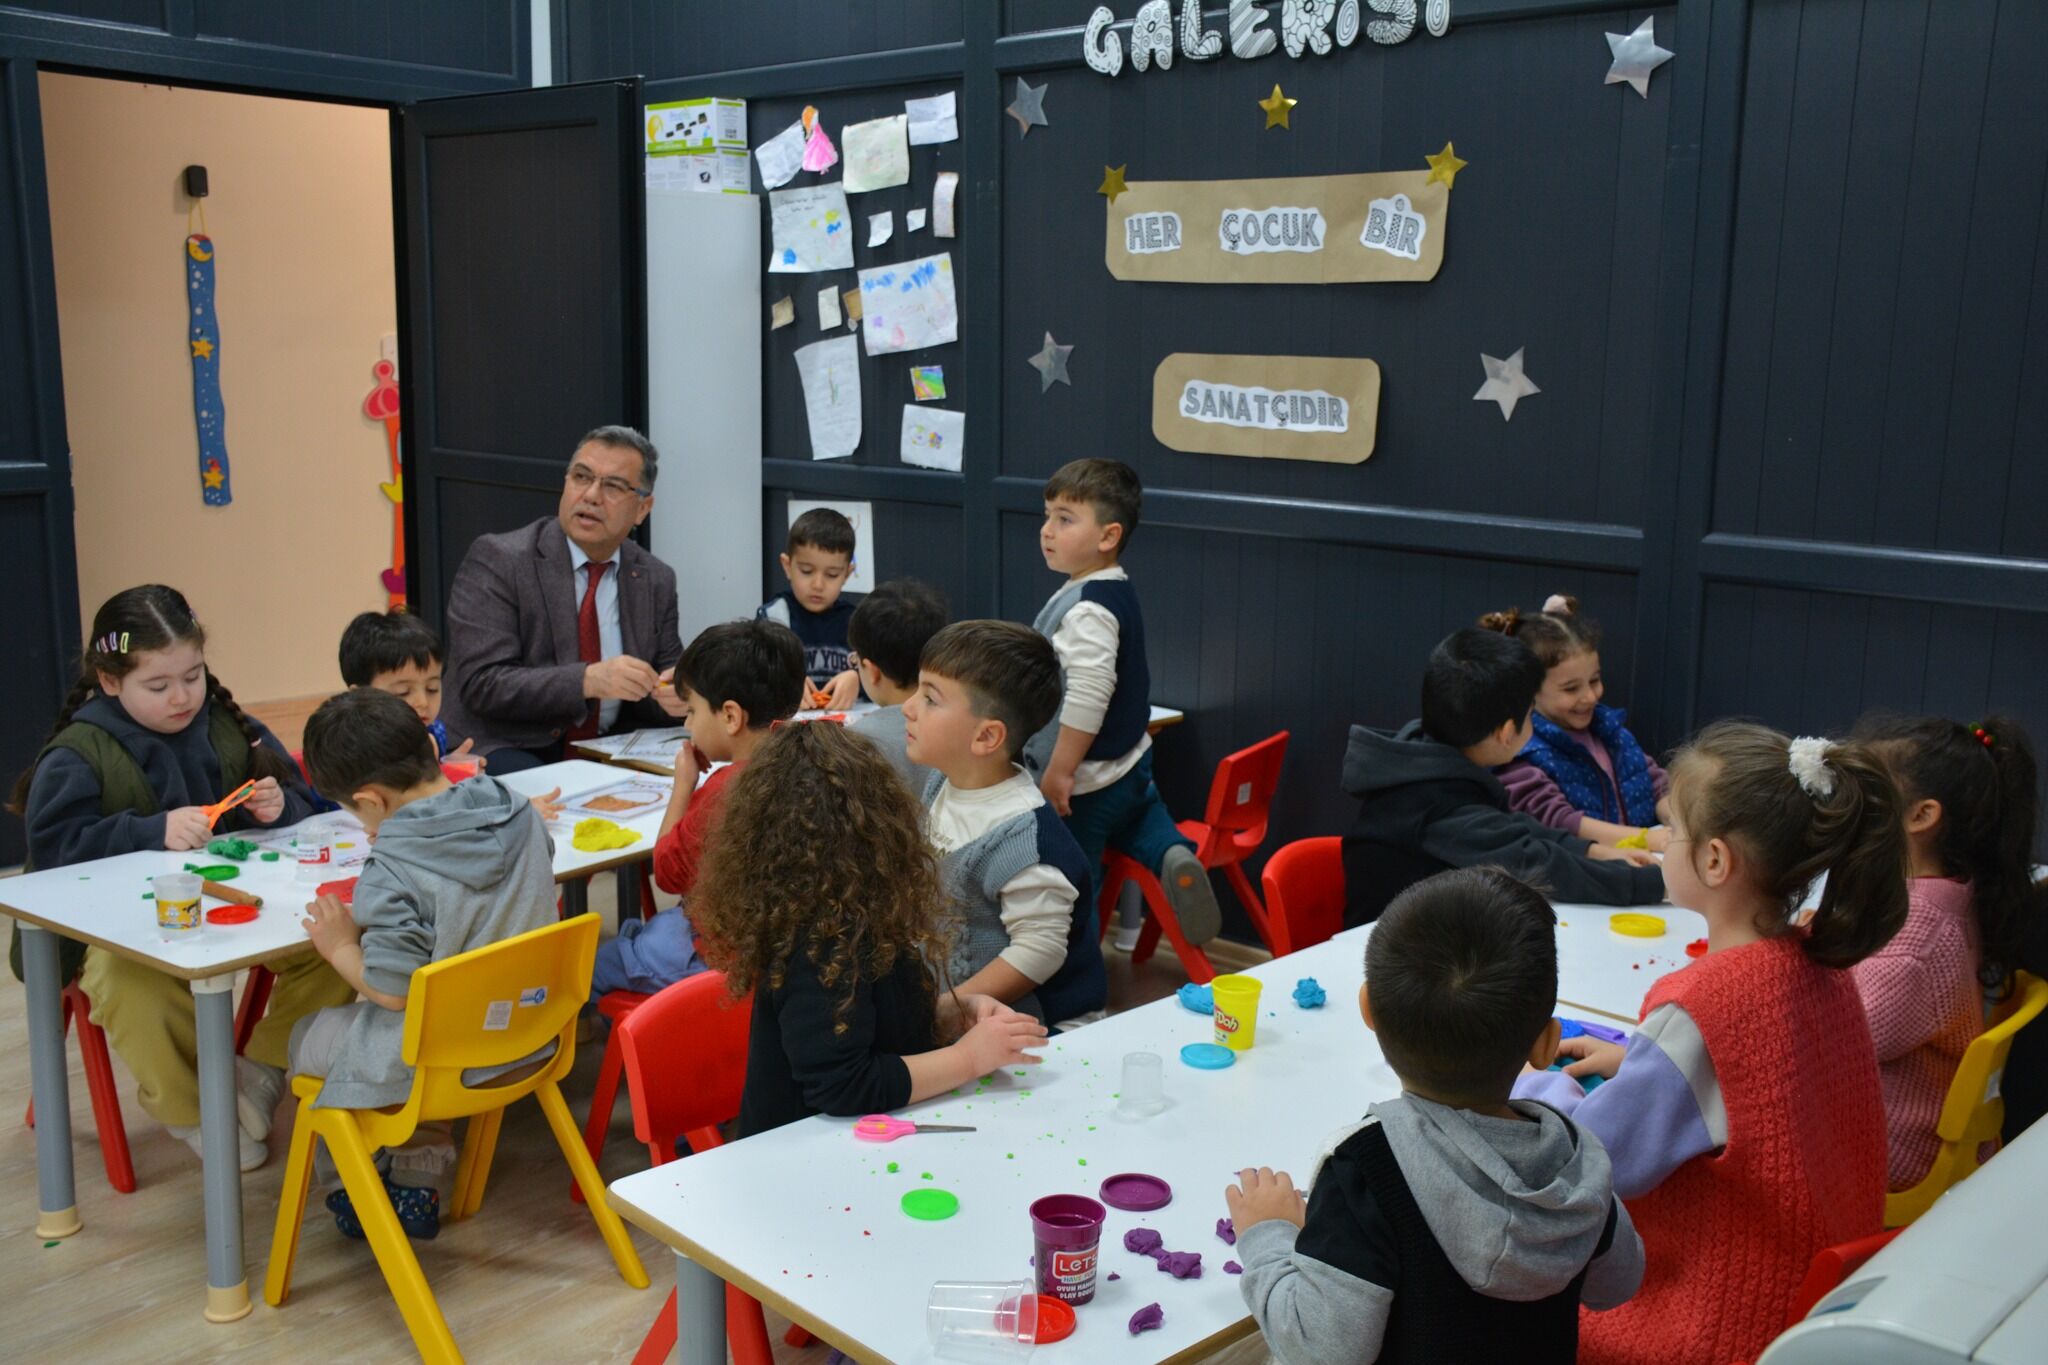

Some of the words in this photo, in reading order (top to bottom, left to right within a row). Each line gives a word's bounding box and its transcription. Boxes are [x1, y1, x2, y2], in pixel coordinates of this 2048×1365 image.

[1129, 215, 1180, 250] HER
[1222, 213, 1321, 250] ÇOCUK
[1365, 198, 1420, 254] BİR
[1185, 387, 1344, 427] SANATÇIDIR
[821, 649, 849, 671] YOR
